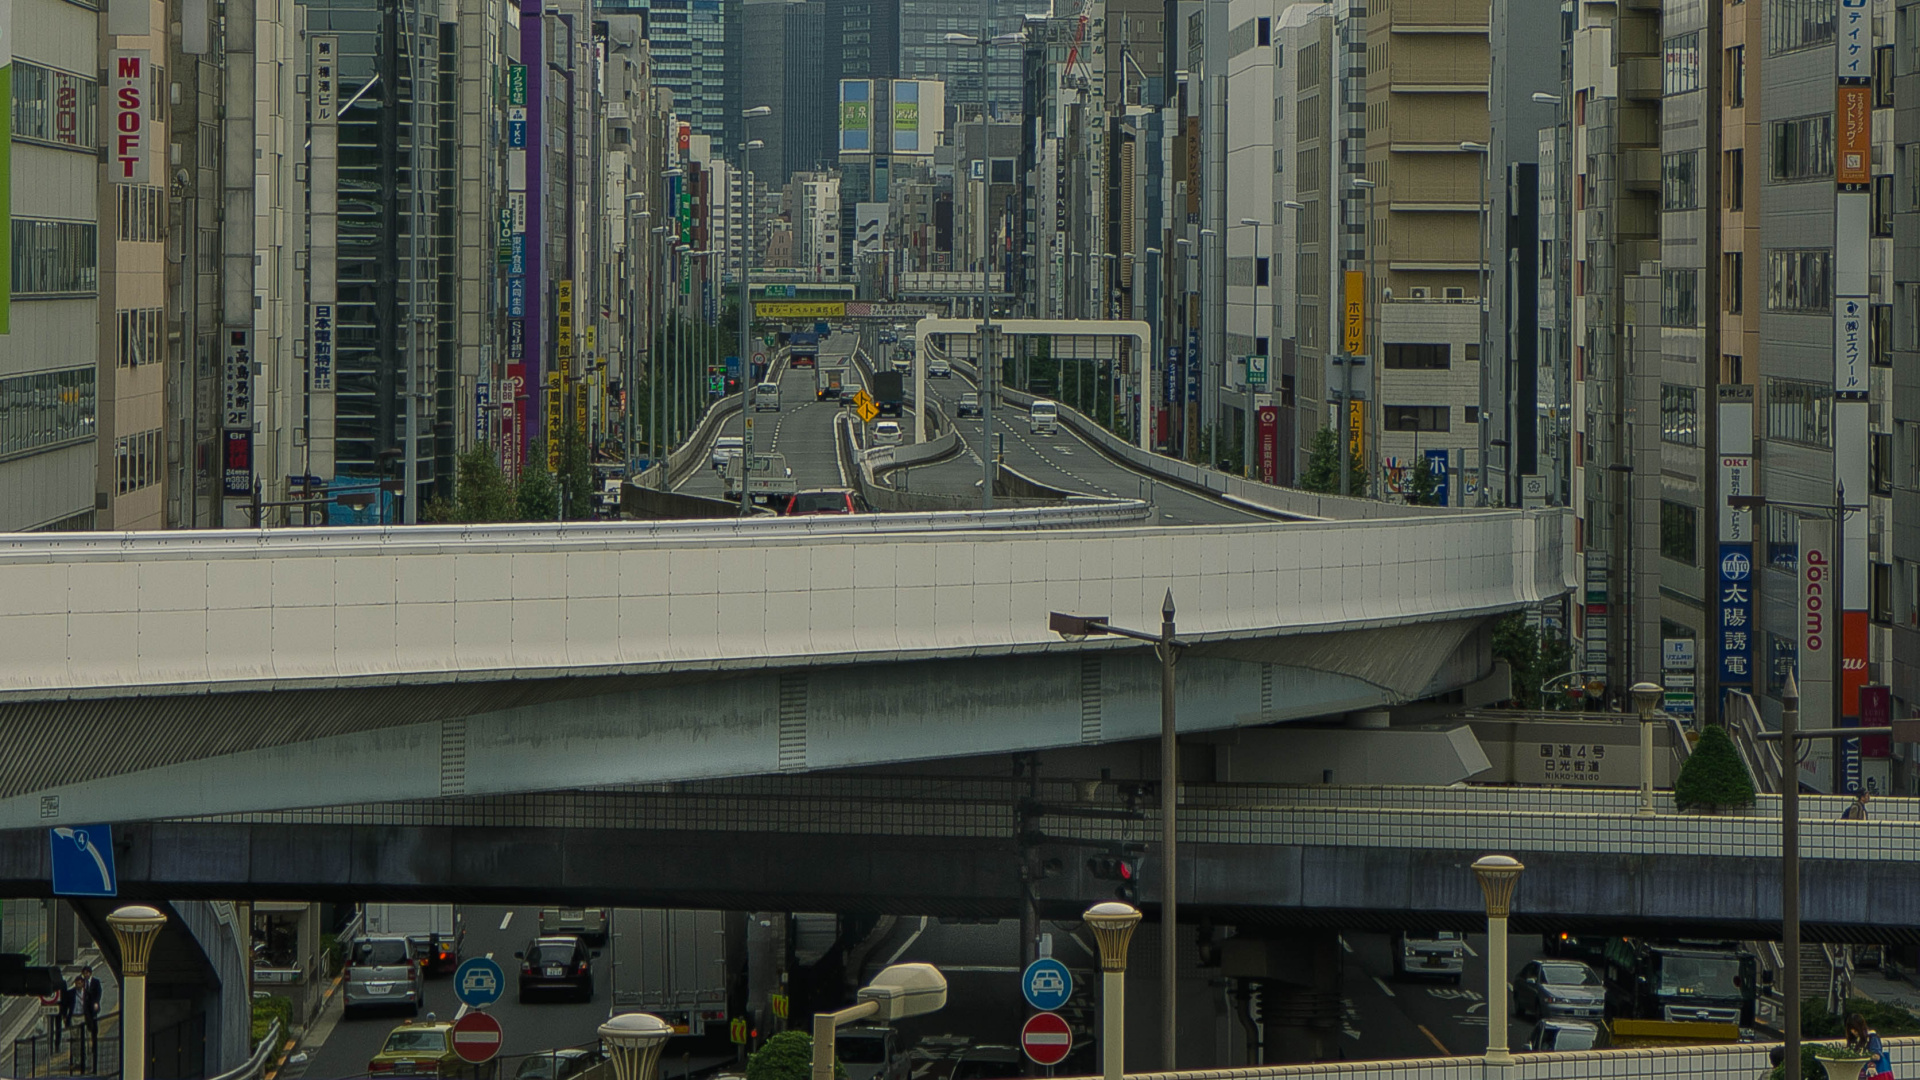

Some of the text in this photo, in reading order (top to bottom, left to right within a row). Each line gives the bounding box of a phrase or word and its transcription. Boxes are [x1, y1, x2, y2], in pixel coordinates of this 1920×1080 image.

[1847, 12, 1861, 71] テイケイ
[1847, 92, 1856, 148] セントラヴィ
[502, 209, 511, 237] RYO
[512, 279, 521, 315] 大同生命
[228, 412, 247, 424] 2F
[1723, 459, 1748, 467] OKI
[1724, 561, 1749, 573] TAIYO
[1807, 550, 1828, 650] docomo
[1723, 584, 1748, 675] 太陽誘電
[1843, 658, 1866, 670] au
[1541, 744, 1605, 759] 国道4号
[1545, 759, 1599, 772] 日光街道
[78, 833, 85, 845] 4
